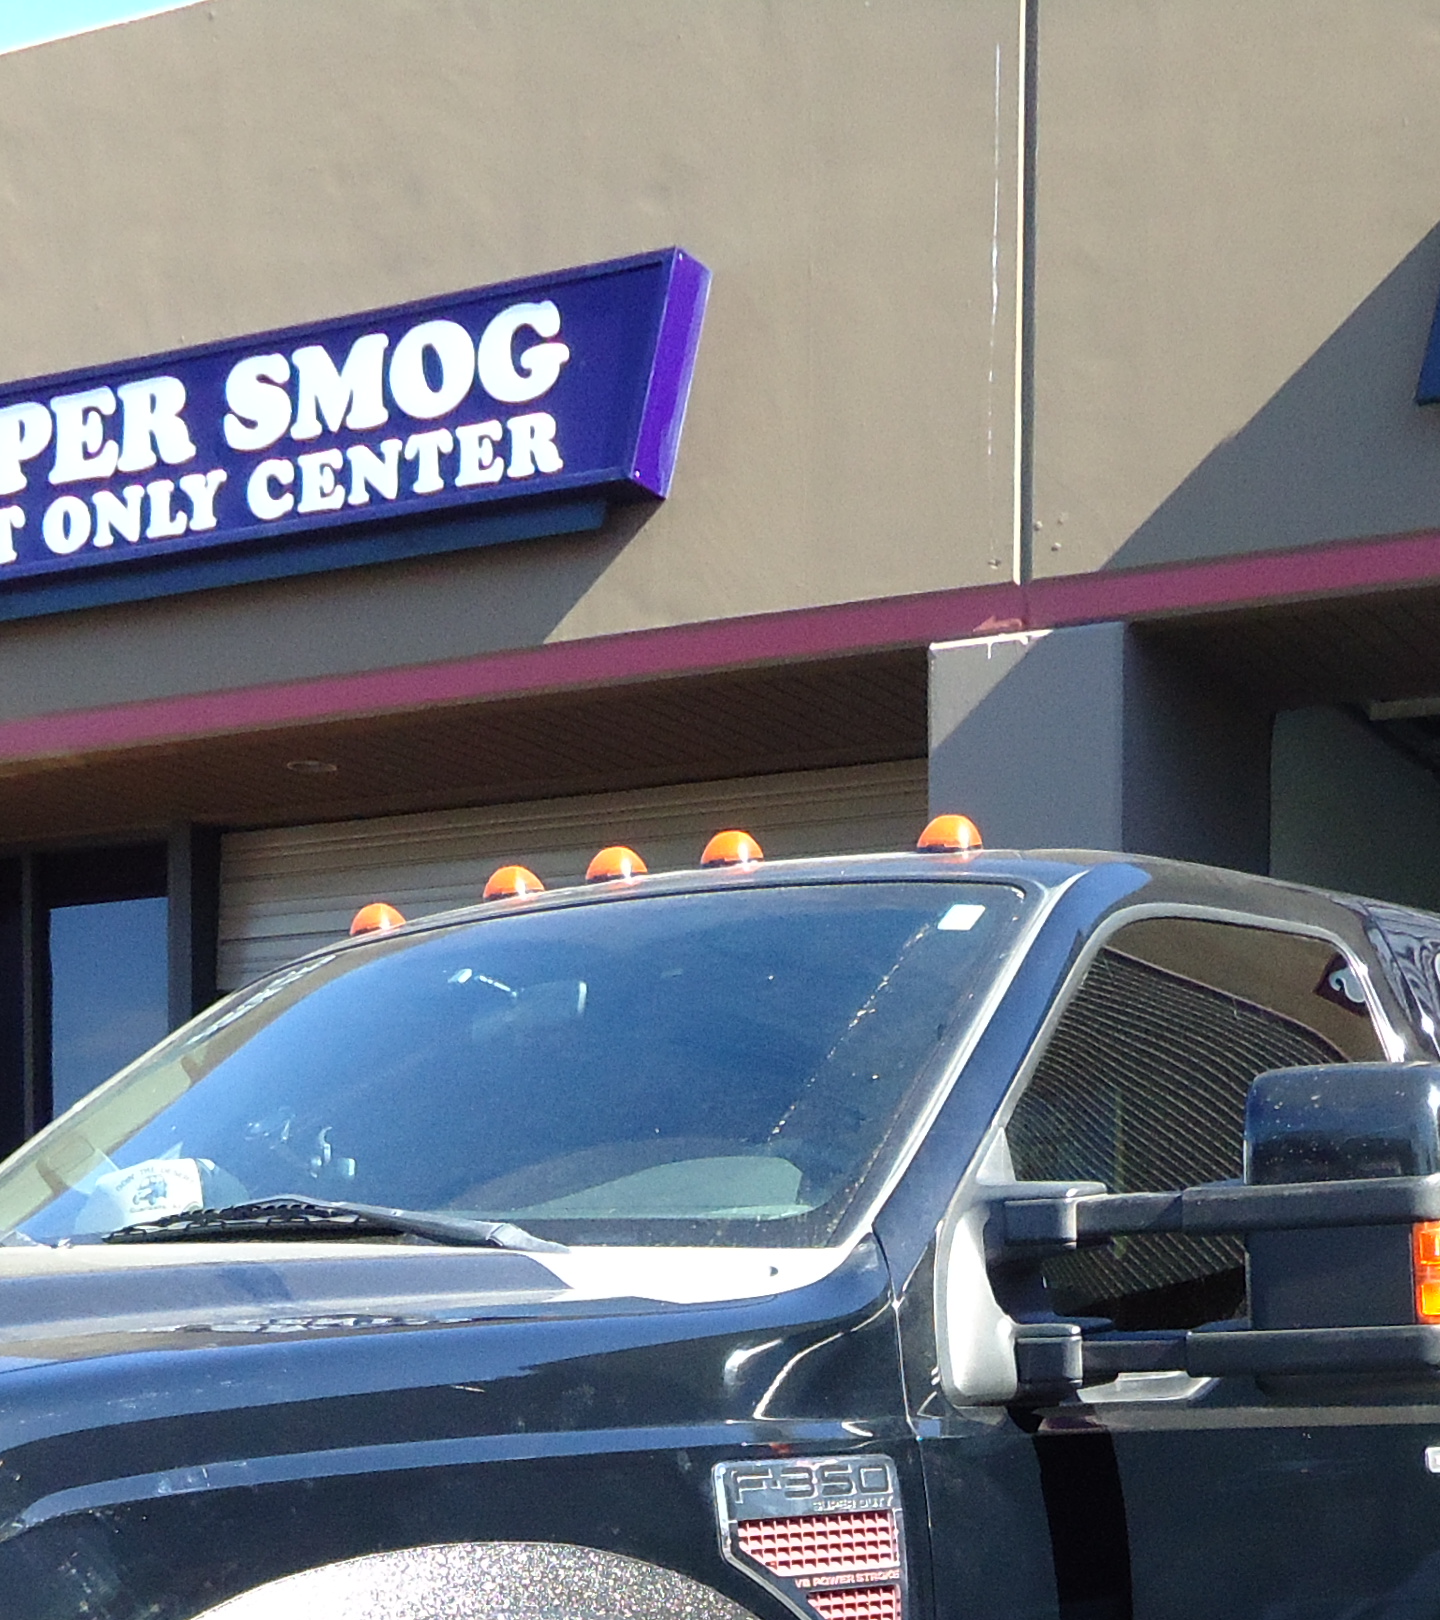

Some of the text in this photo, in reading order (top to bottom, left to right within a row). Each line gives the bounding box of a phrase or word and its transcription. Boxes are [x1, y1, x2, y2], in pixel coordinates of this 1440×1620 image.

[222, 300, 570, 454] SMOG
[42, 470, 226, 556] ONLY
[246, 412, 564, 518] CENTER
[731, 1464, 894, 1503] F-350
